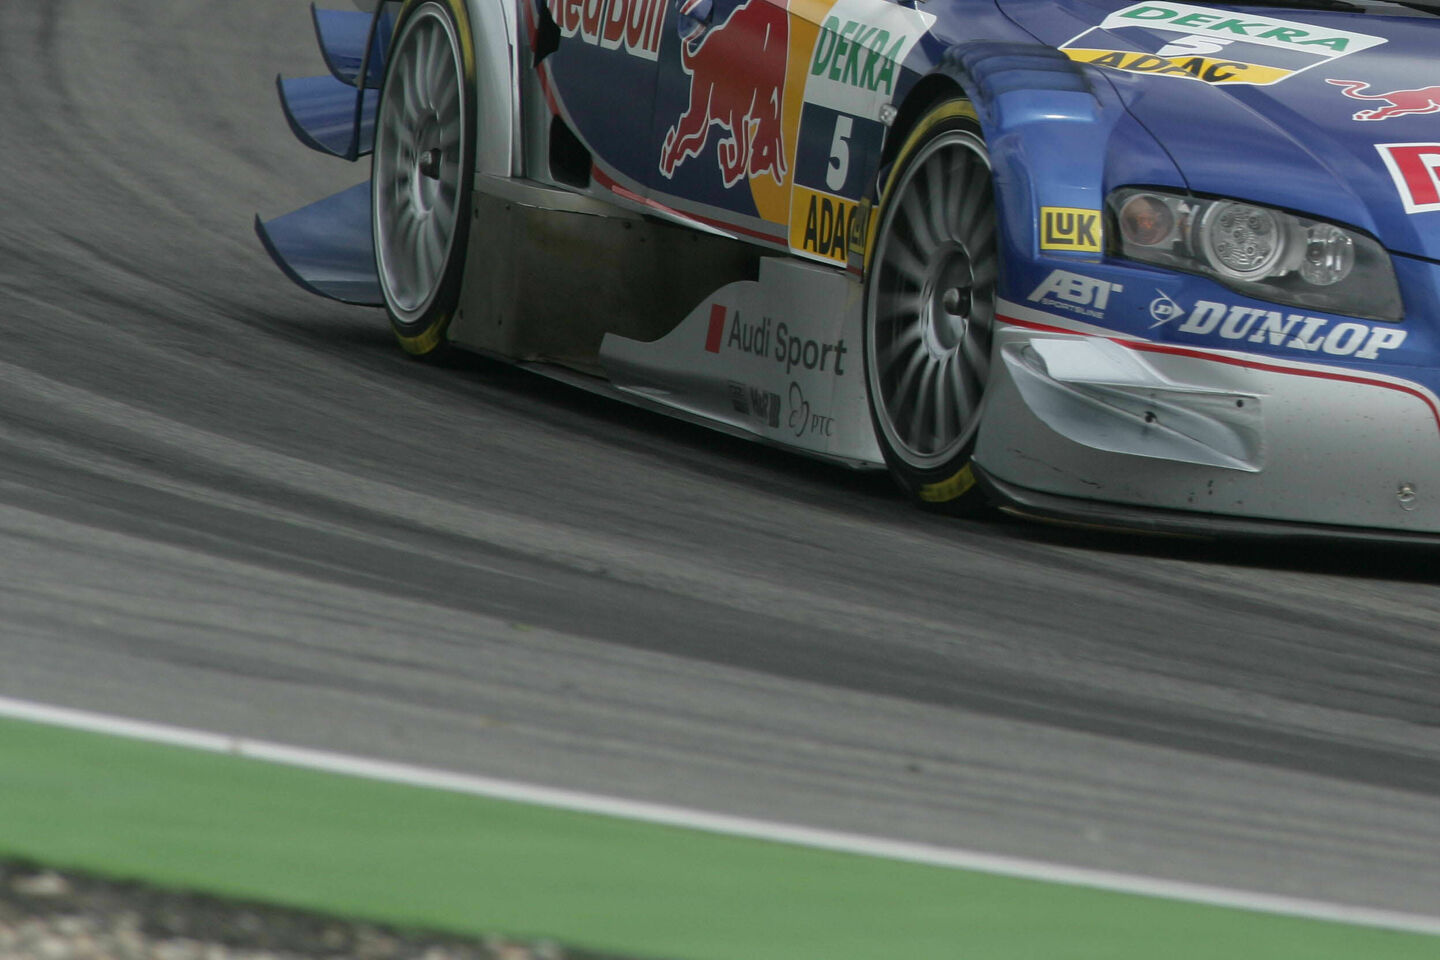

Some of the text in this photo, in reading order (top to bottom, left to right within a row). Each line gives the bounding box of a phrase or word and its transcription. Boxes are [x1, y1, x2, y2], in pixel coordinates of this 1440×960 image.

[810, 16, 908, 95] DEKRA
[1119, 6, 1352, 53] DEKRA
[1095, 51, 1249, 82] ADAC
[826, 116, 852, 191] 5
[1027, 268, 1124, 310] ABT
[728, 310, 848, 376] Audi Sport
[1179, 299, 1408, 360] DUNLOP
